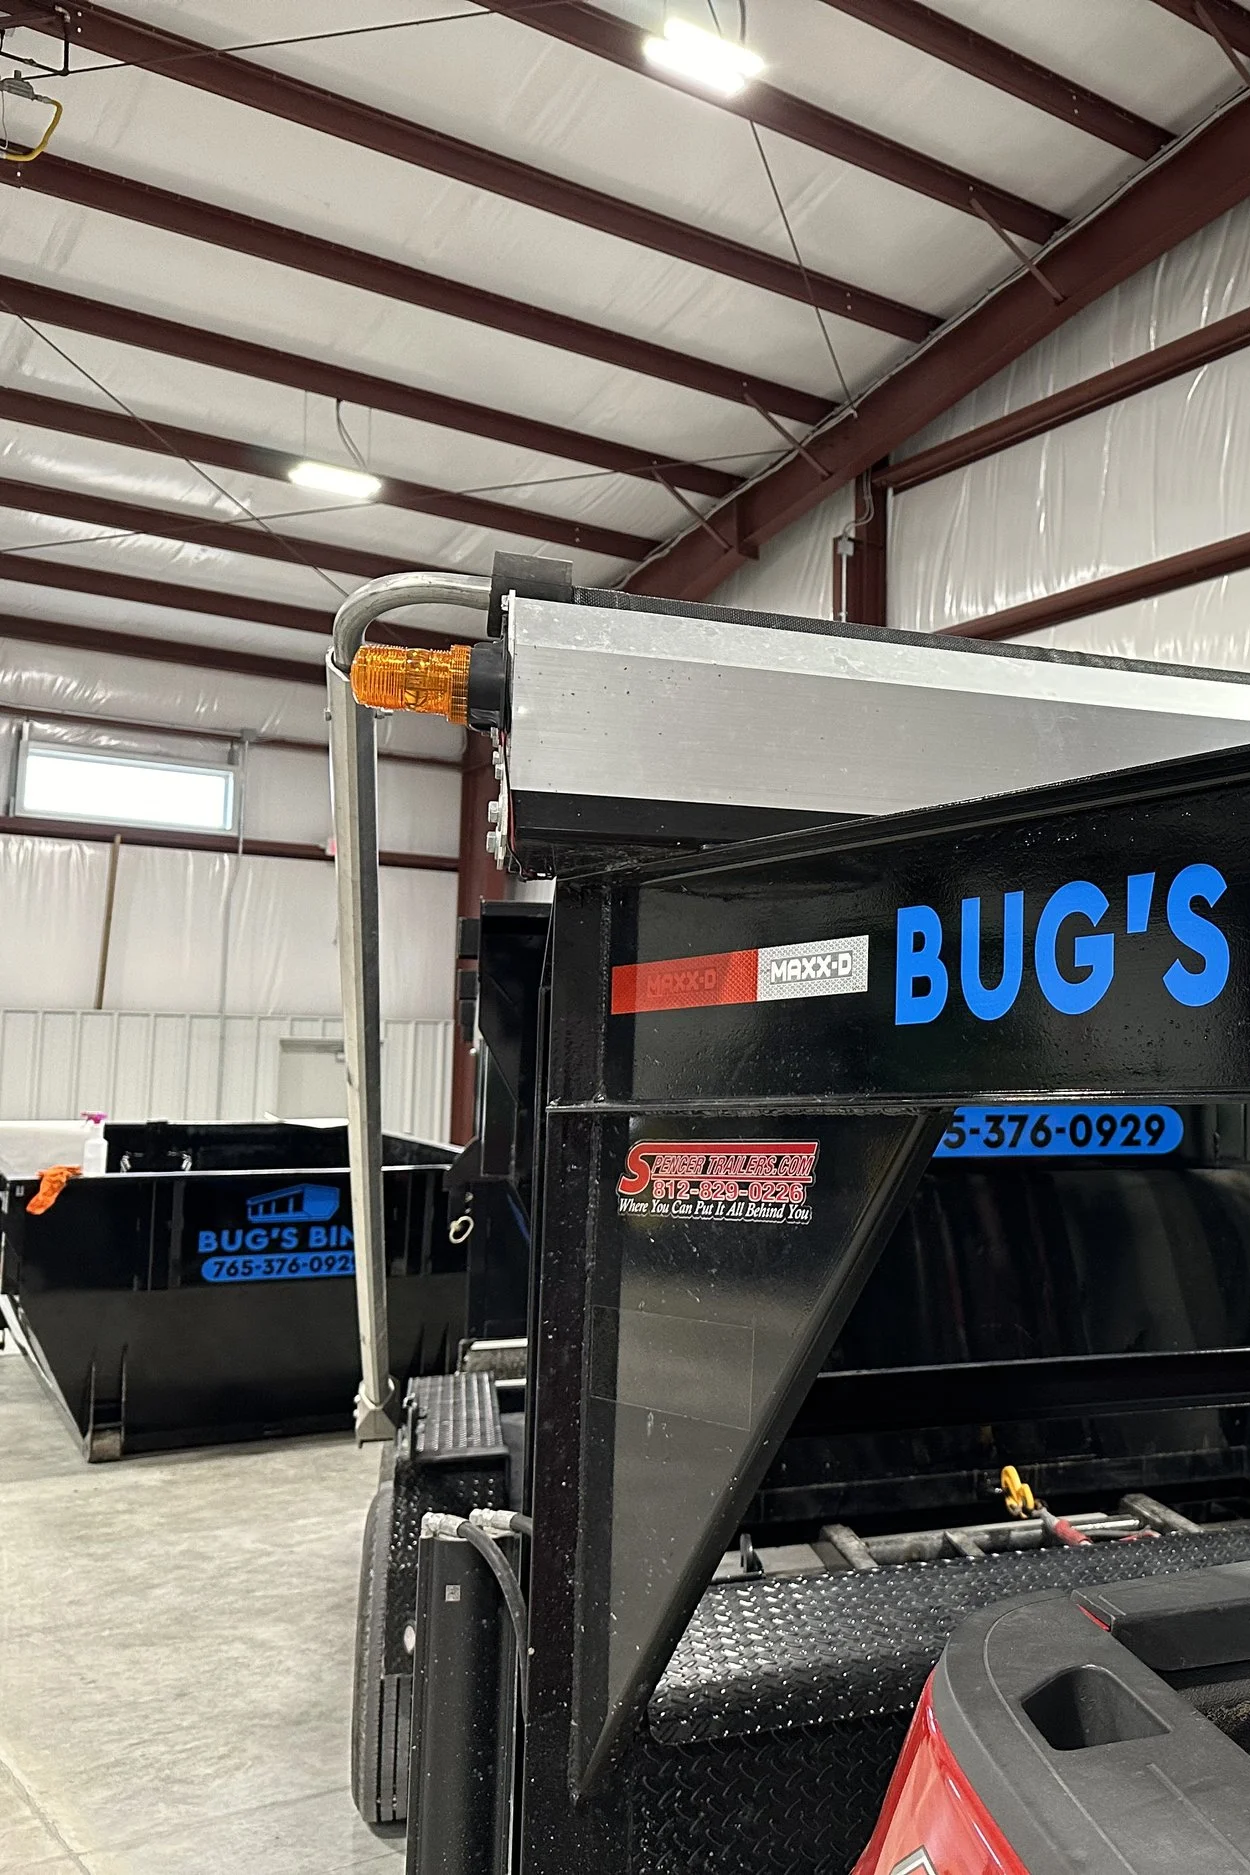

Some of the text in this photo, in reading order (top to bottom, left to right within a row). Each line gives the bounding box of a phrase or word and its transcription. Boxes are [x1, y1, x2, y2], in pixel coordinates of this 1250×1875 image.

[894, 863, 1230, 1026] BUG'S
[647, 968, 717, 997] MAXX-D
[771, 953, 852, 984] MAXX-D
[943, 1113, 1166, 1149] 5-376-0929
[619, 1142, 815, 1195] SPENCER TRAILERS.COM
[653, 1181, 804, 1203] 812-829-0226
[619, 1198, 810, 1220] Where You Can Put It All Behind You
[198, 1225, 354, 1253] BUG'S BIN
[213, 1255, 356, 1278] 765-376-092
